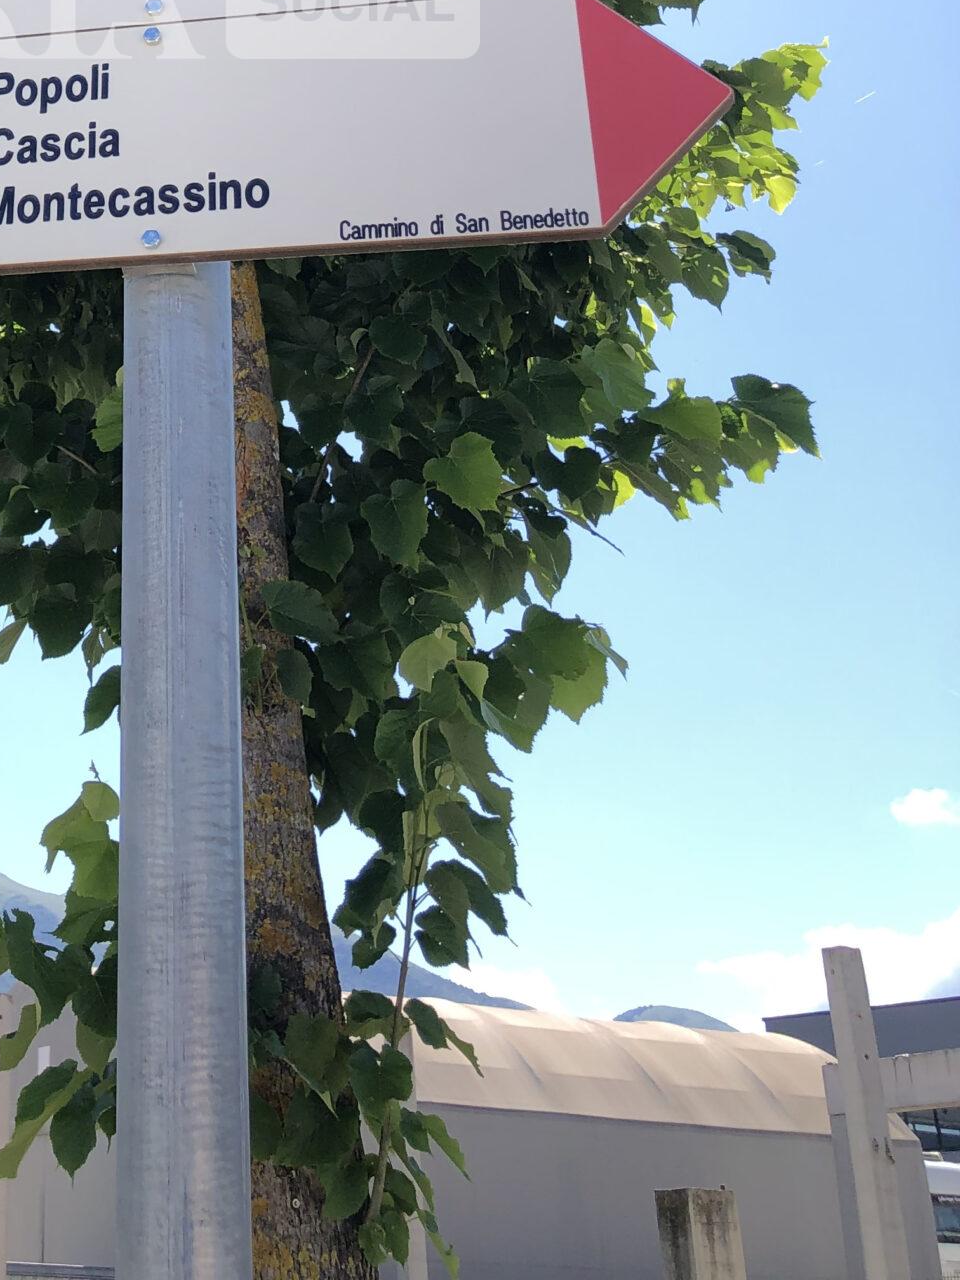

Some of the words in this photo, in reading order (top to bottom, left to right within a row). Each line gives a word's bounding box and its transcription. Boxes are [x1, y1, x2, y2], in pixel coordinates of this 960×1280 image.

[339, 216, 419, 241] Cammino
[430, 214, 444, 235] di
[455, 212, 490, 234] San
[499, 207, 590, 232] Benedetto
